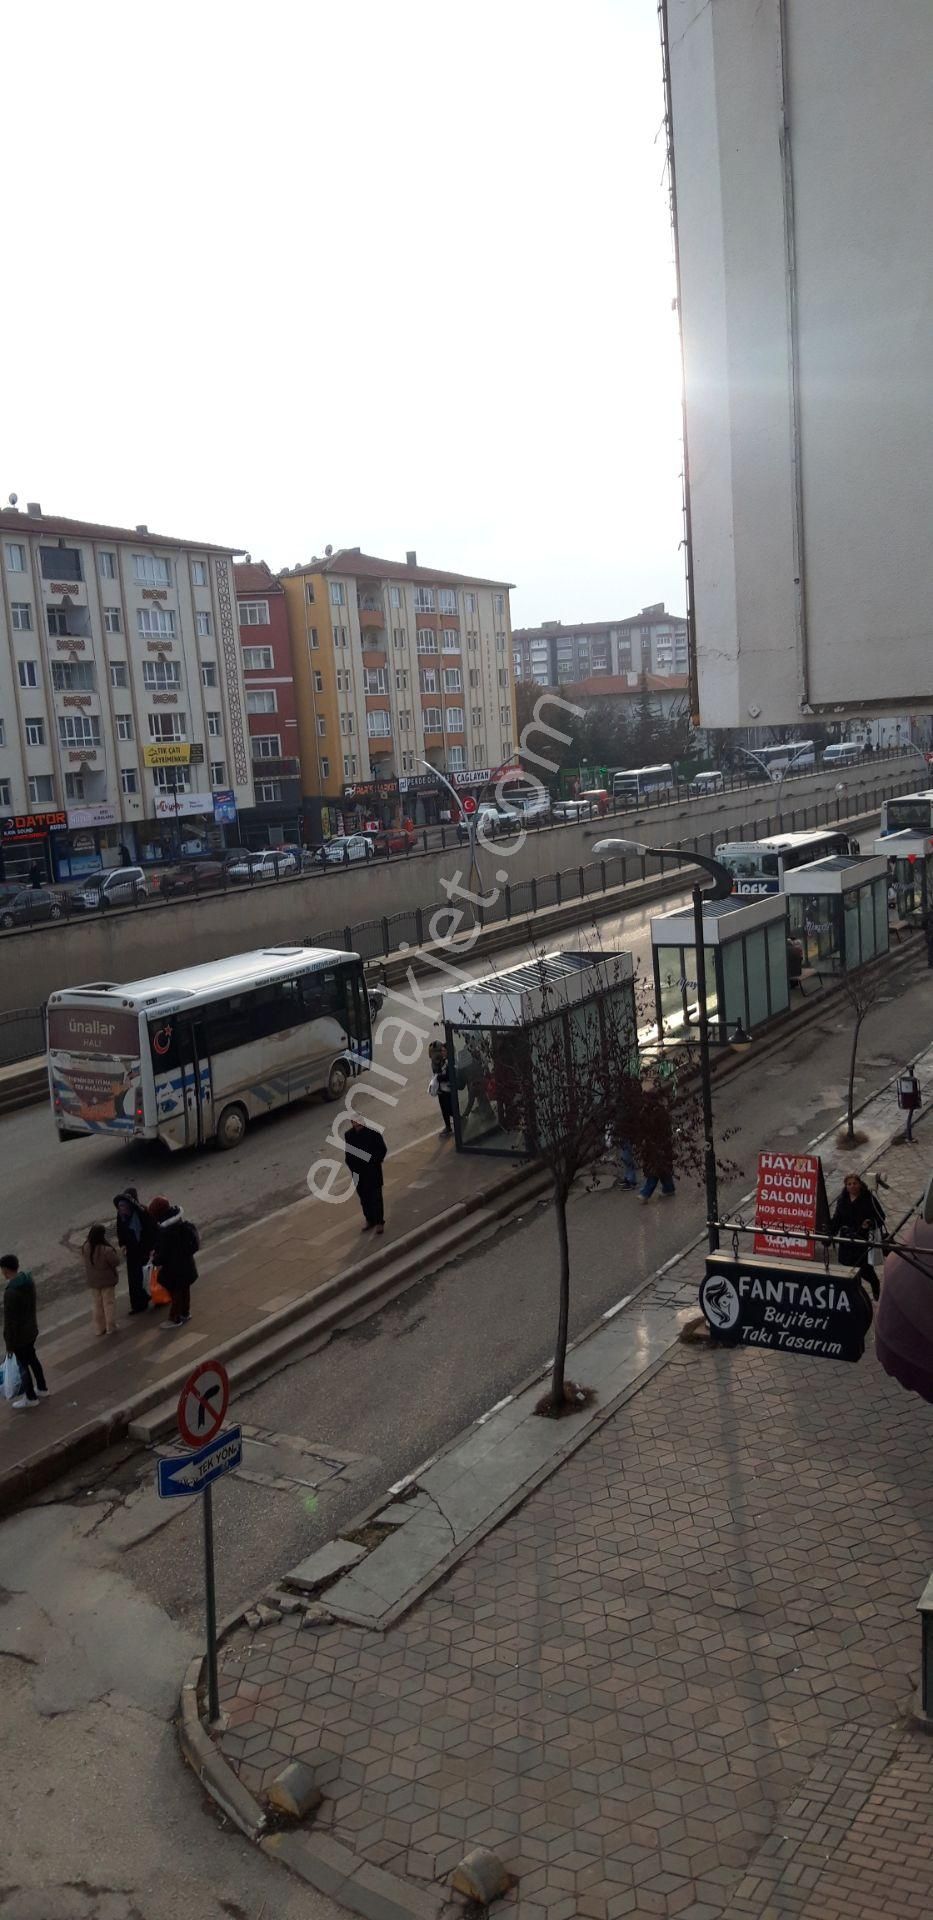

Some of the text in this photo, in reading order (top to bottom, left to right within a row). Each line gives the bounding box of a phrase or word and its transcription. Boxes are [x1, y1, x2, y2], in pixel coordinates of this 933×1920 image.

[69, 1018, 115, 1036] ünallar
[764, 1172, 811, 1190] DÜĞÜN
[760, 1189, 813, 1205] SALONU
[758, 1204, 813, 1217] HOŞ GELDİNİZ
[738, 1276, 851, 1312] FANTASİA
[763, 1306, 830, 1330] Bujiteri
[742, 1326, 842, 1354] Takı Tasarım
[198, 1457, 214, 1476] TEK
